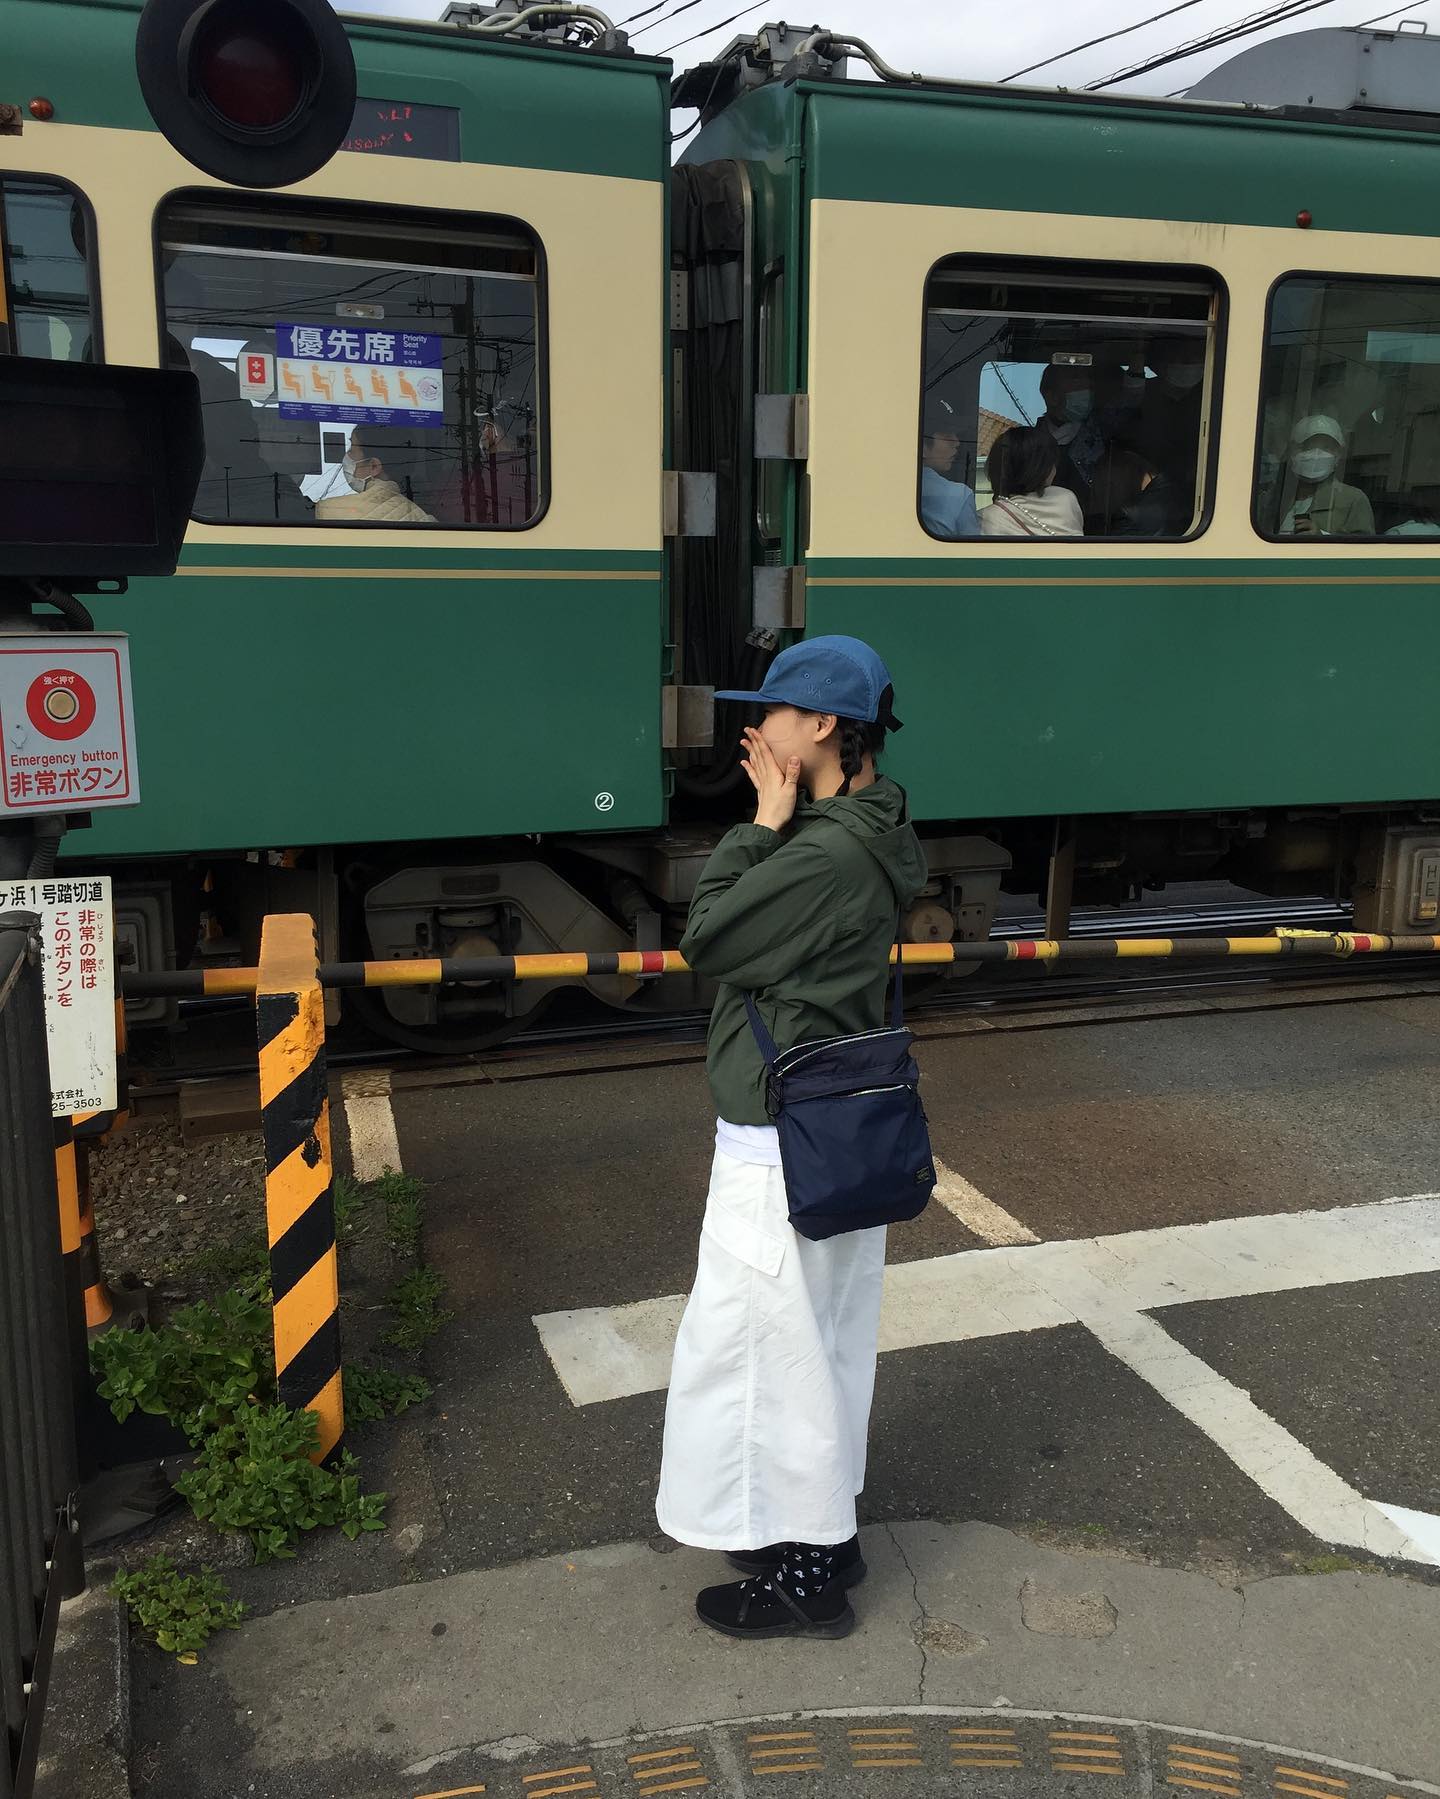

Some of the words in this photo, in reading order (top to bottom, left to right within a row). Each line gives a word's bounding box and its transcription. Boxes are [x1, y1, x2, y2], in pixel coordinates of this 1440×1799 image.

[290, 326, 396, 363] 優先席
[403, 334, 427, 344] Priority
[403, 341, 419, 349] Seat
[43, 676, 75, 685] 強く押す
[11, 753, 76, 767] Emergency
[82, 750, 119, 762] button
[10, 767, 122, 798] 非常ボタン
[55, 912, 72, 1007] このボタンを
[79, 910, 97, 989] 非常の際は
